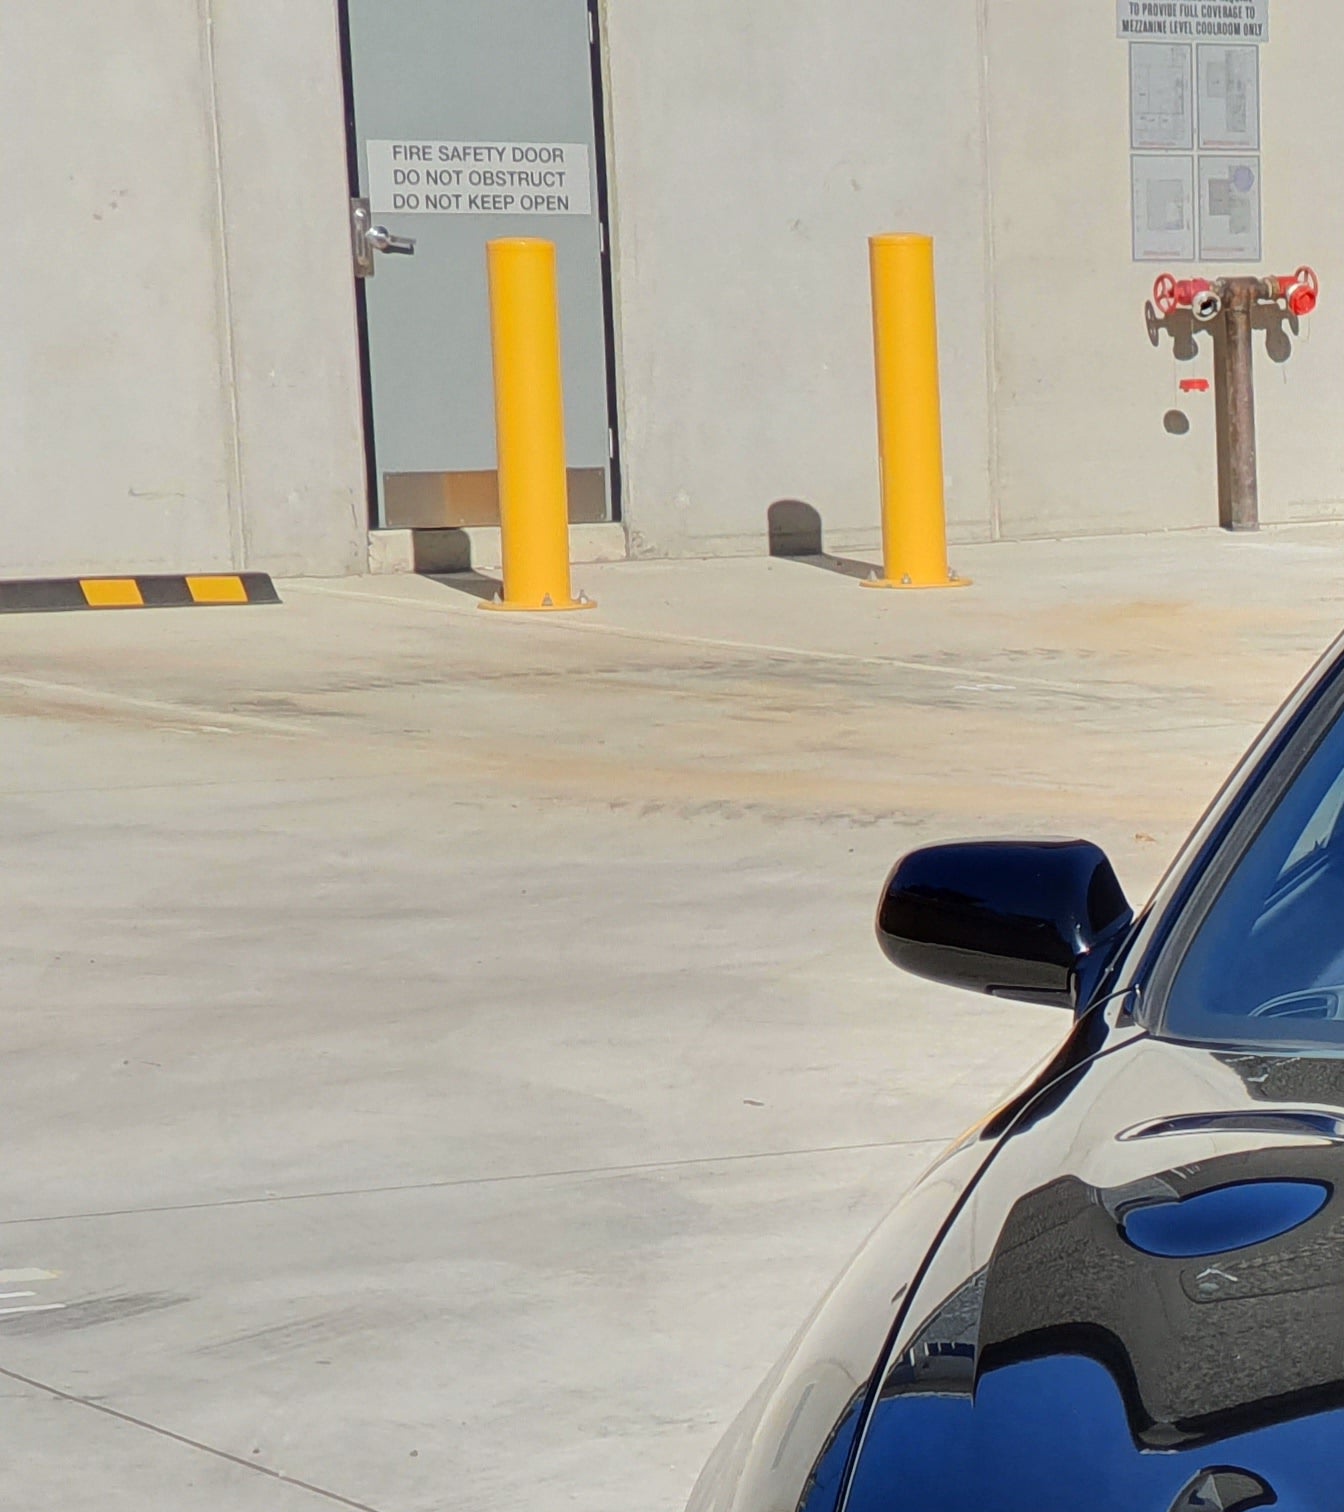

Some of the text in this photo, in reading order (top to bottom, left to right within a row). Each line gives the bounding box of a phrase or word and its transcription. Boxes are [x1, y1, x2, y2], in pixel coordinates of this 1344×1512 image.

[1128, 2, 1256, 20] TO PROVIDE FULL COVERAGE TO
[1121, 19, 1263, 36] MEZZANINE LEVEL COOLROOM ONLY
[392, 145, 565, 163] FIRE SAFETY DOOR
[393, 169, 567, 188] DO NOT OBSTRUCT
[392, 193, 569, 211] DO NOT KEEP OPEN
